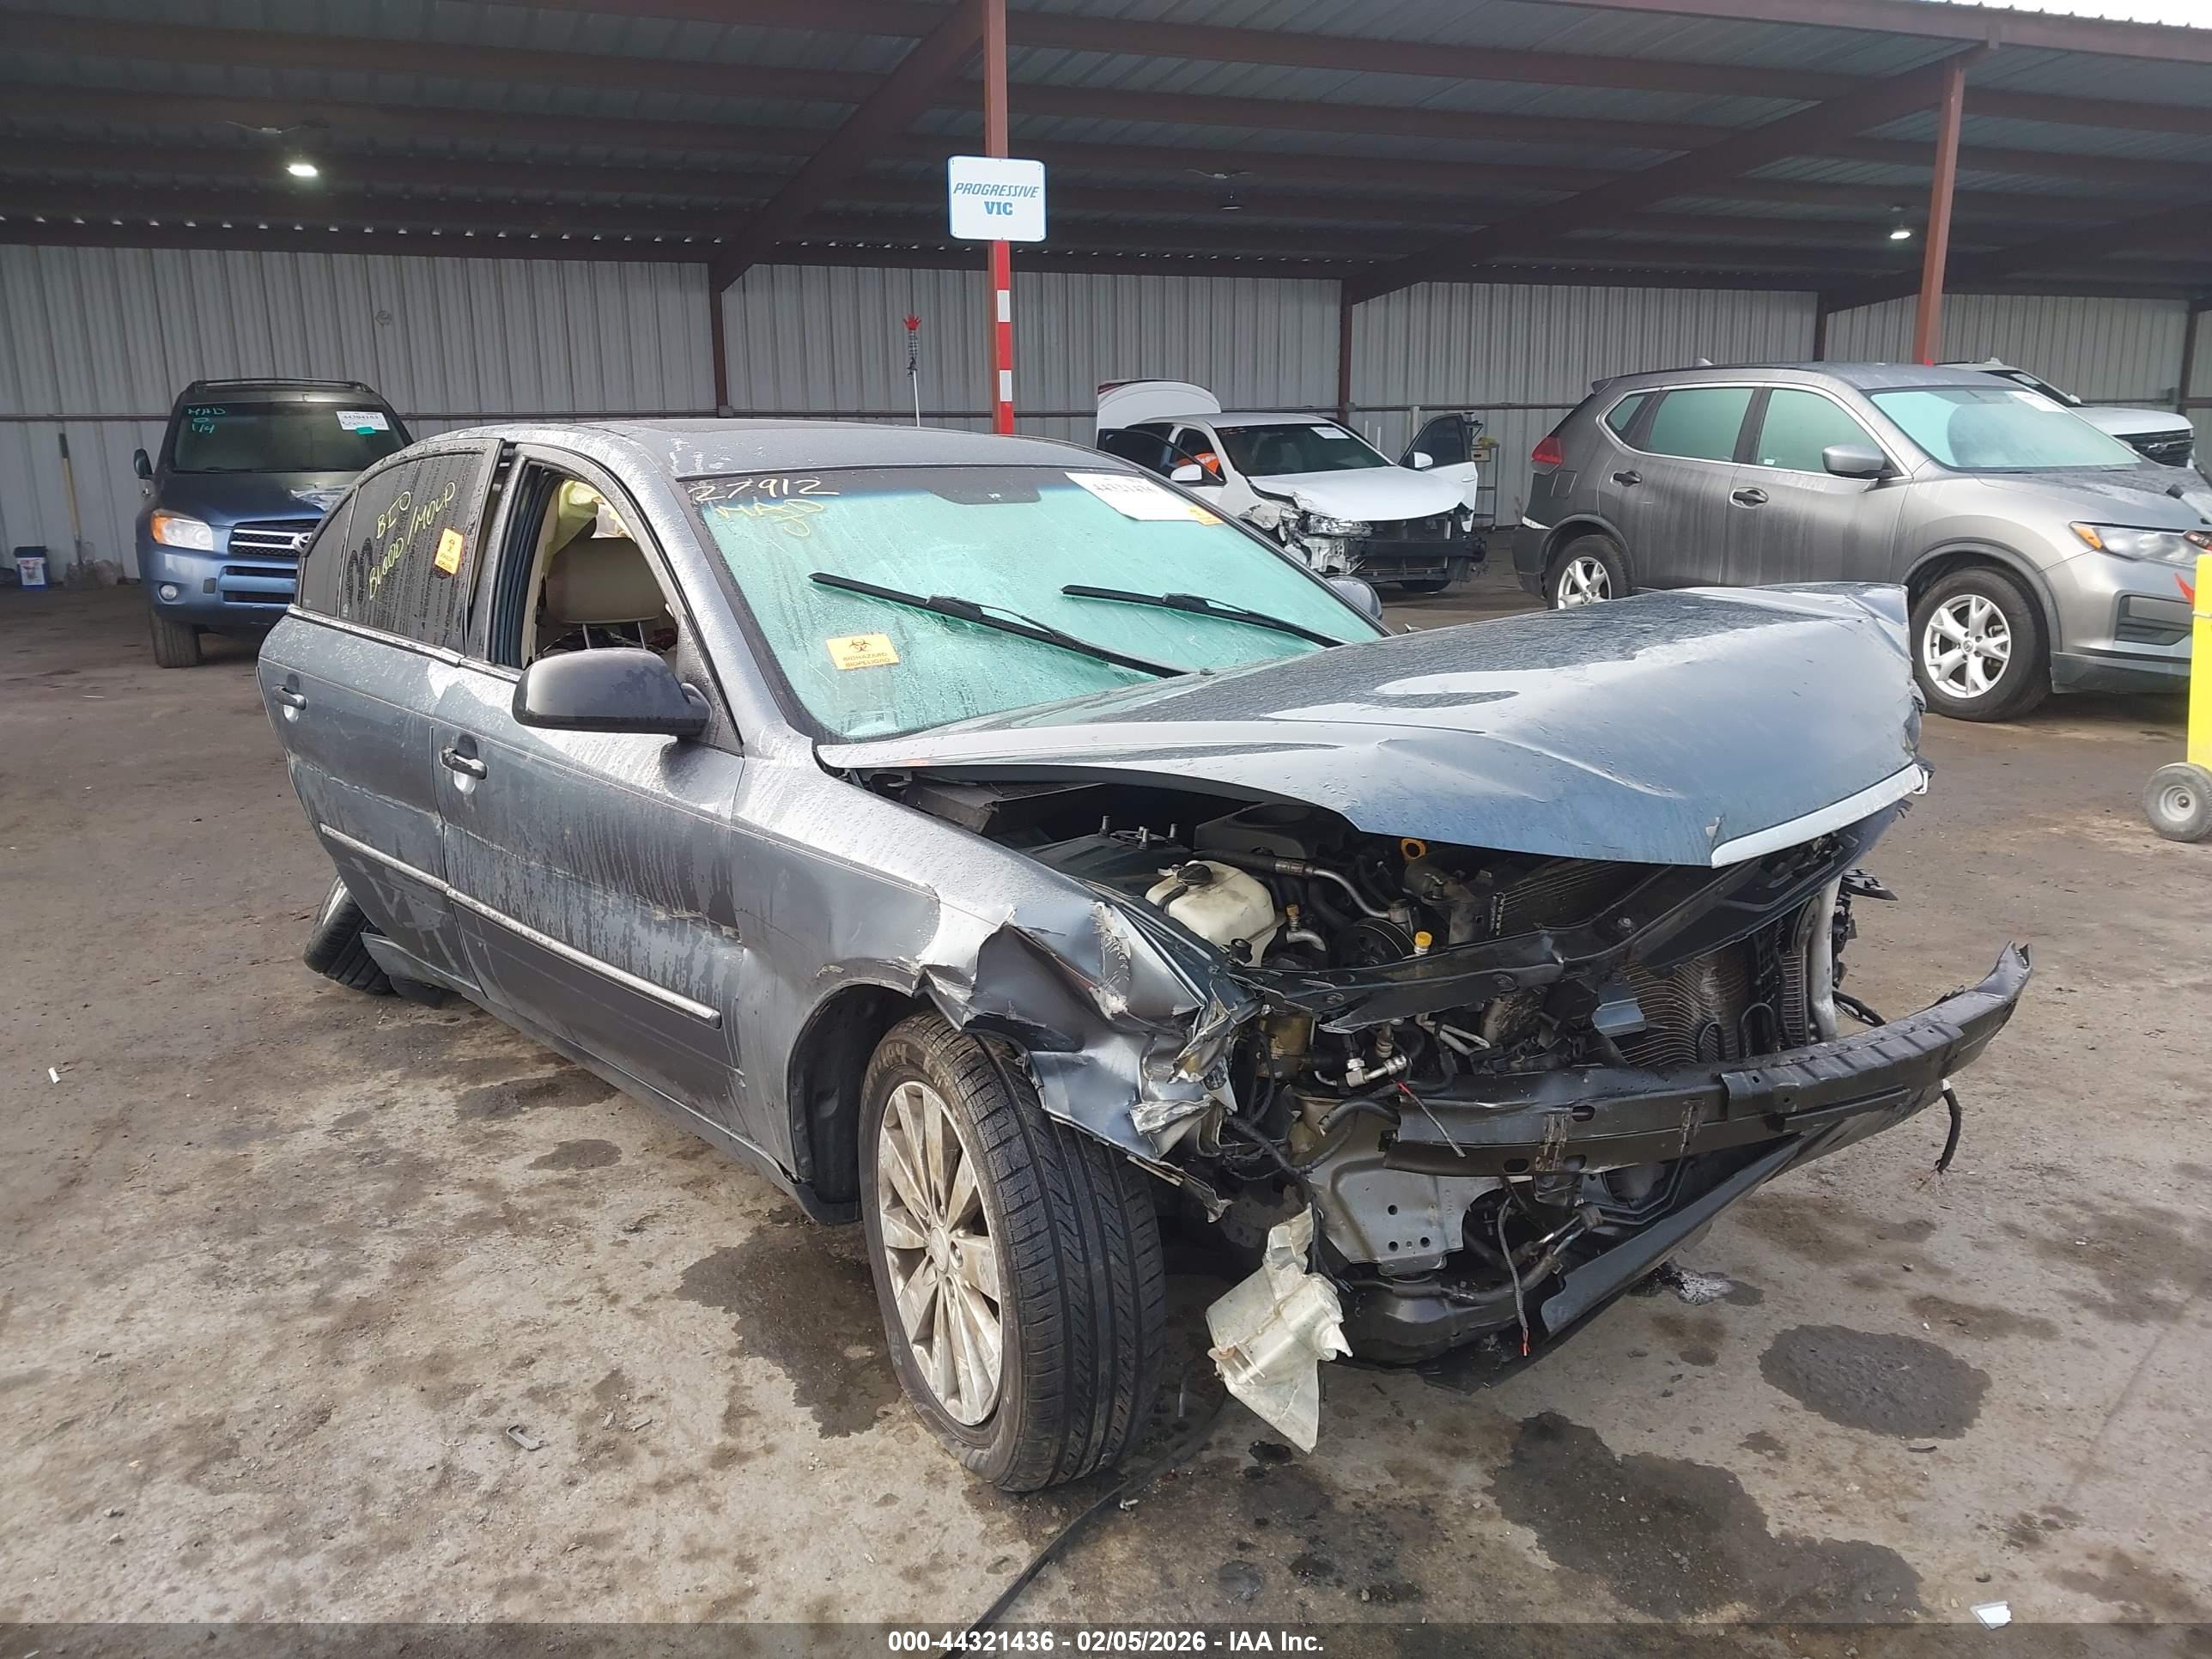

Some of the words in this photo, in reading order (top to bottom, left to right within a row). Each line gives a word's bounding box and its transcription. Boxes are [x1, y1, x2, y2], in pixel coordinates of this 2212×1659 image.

[952, 182, 1040, 198] PROGRESSIVE
[983, 201, 1014, 216] VIC
[688, 477, 841, 501] 27912
